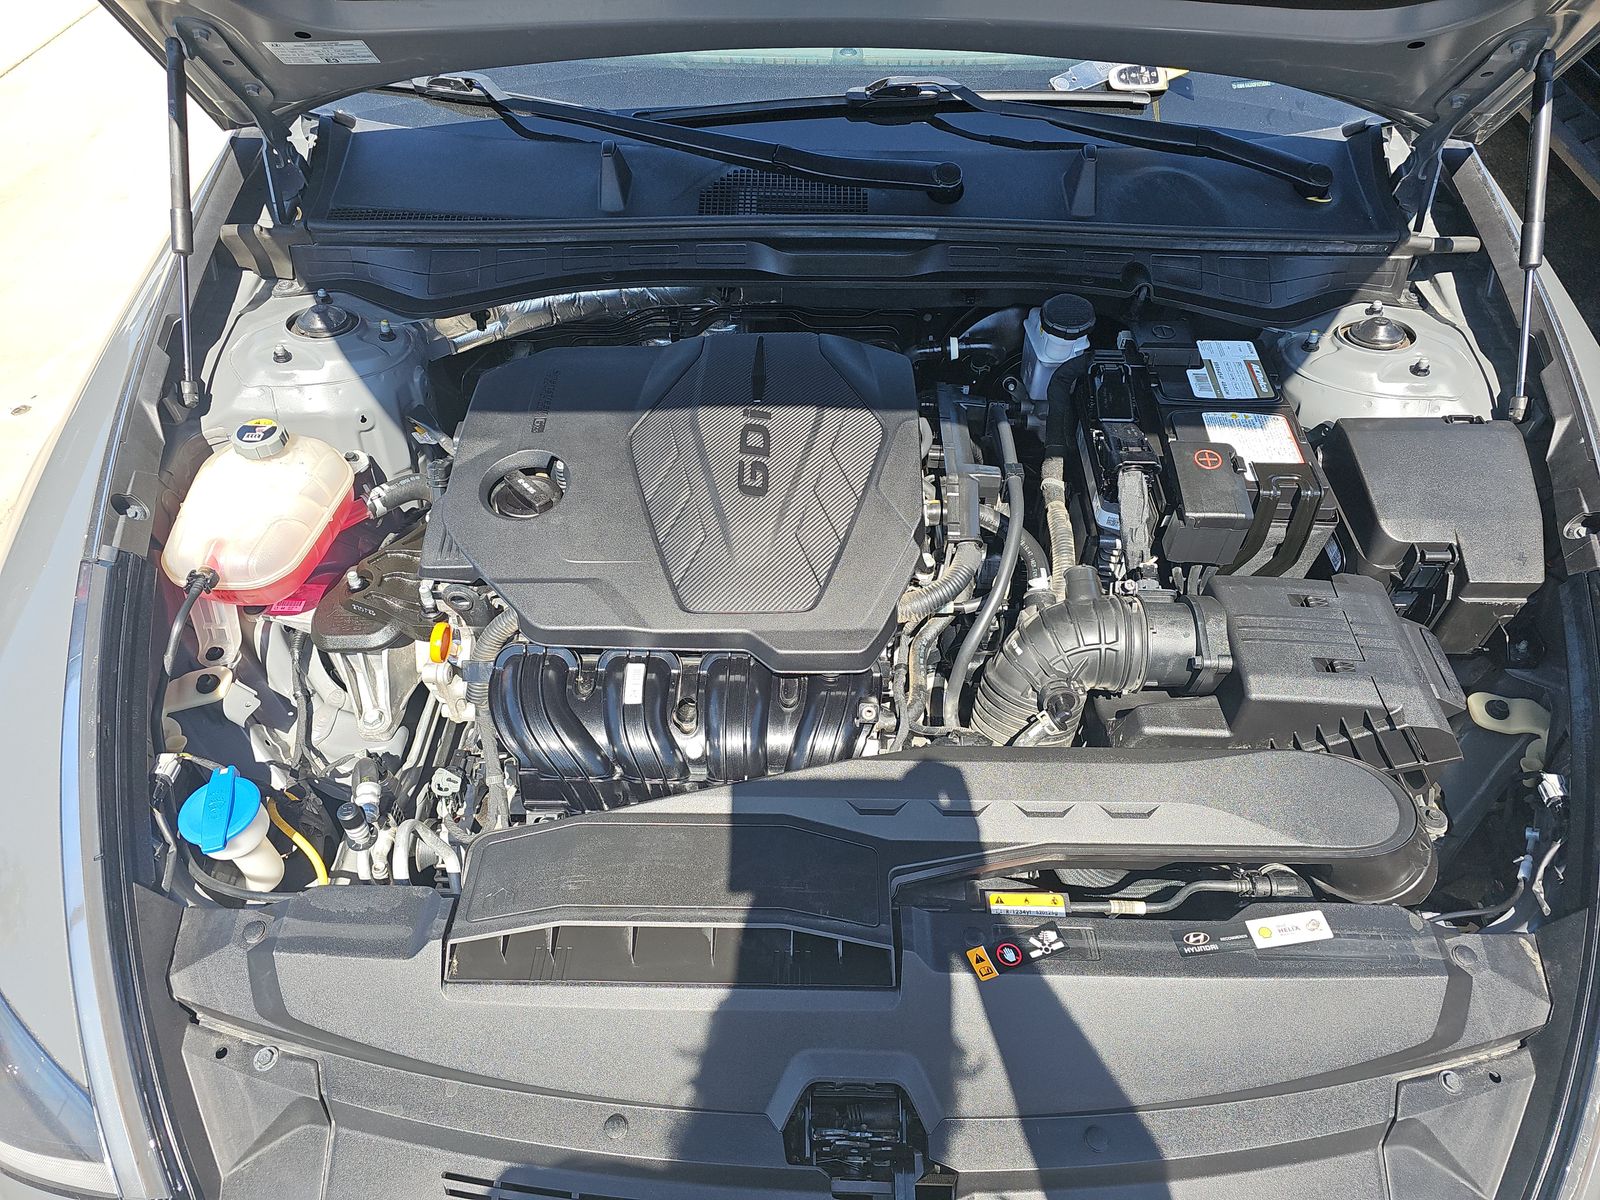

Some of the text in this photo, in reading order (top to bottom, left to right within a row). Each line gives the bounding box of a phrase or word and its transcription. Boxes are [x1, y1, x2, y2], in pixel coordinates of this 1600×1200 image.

[1251, 363, 1268, 392] ACDelco
[738, 408, 771, 498] GDi
[1184, 944, 1219, 953] HYUNDAI
